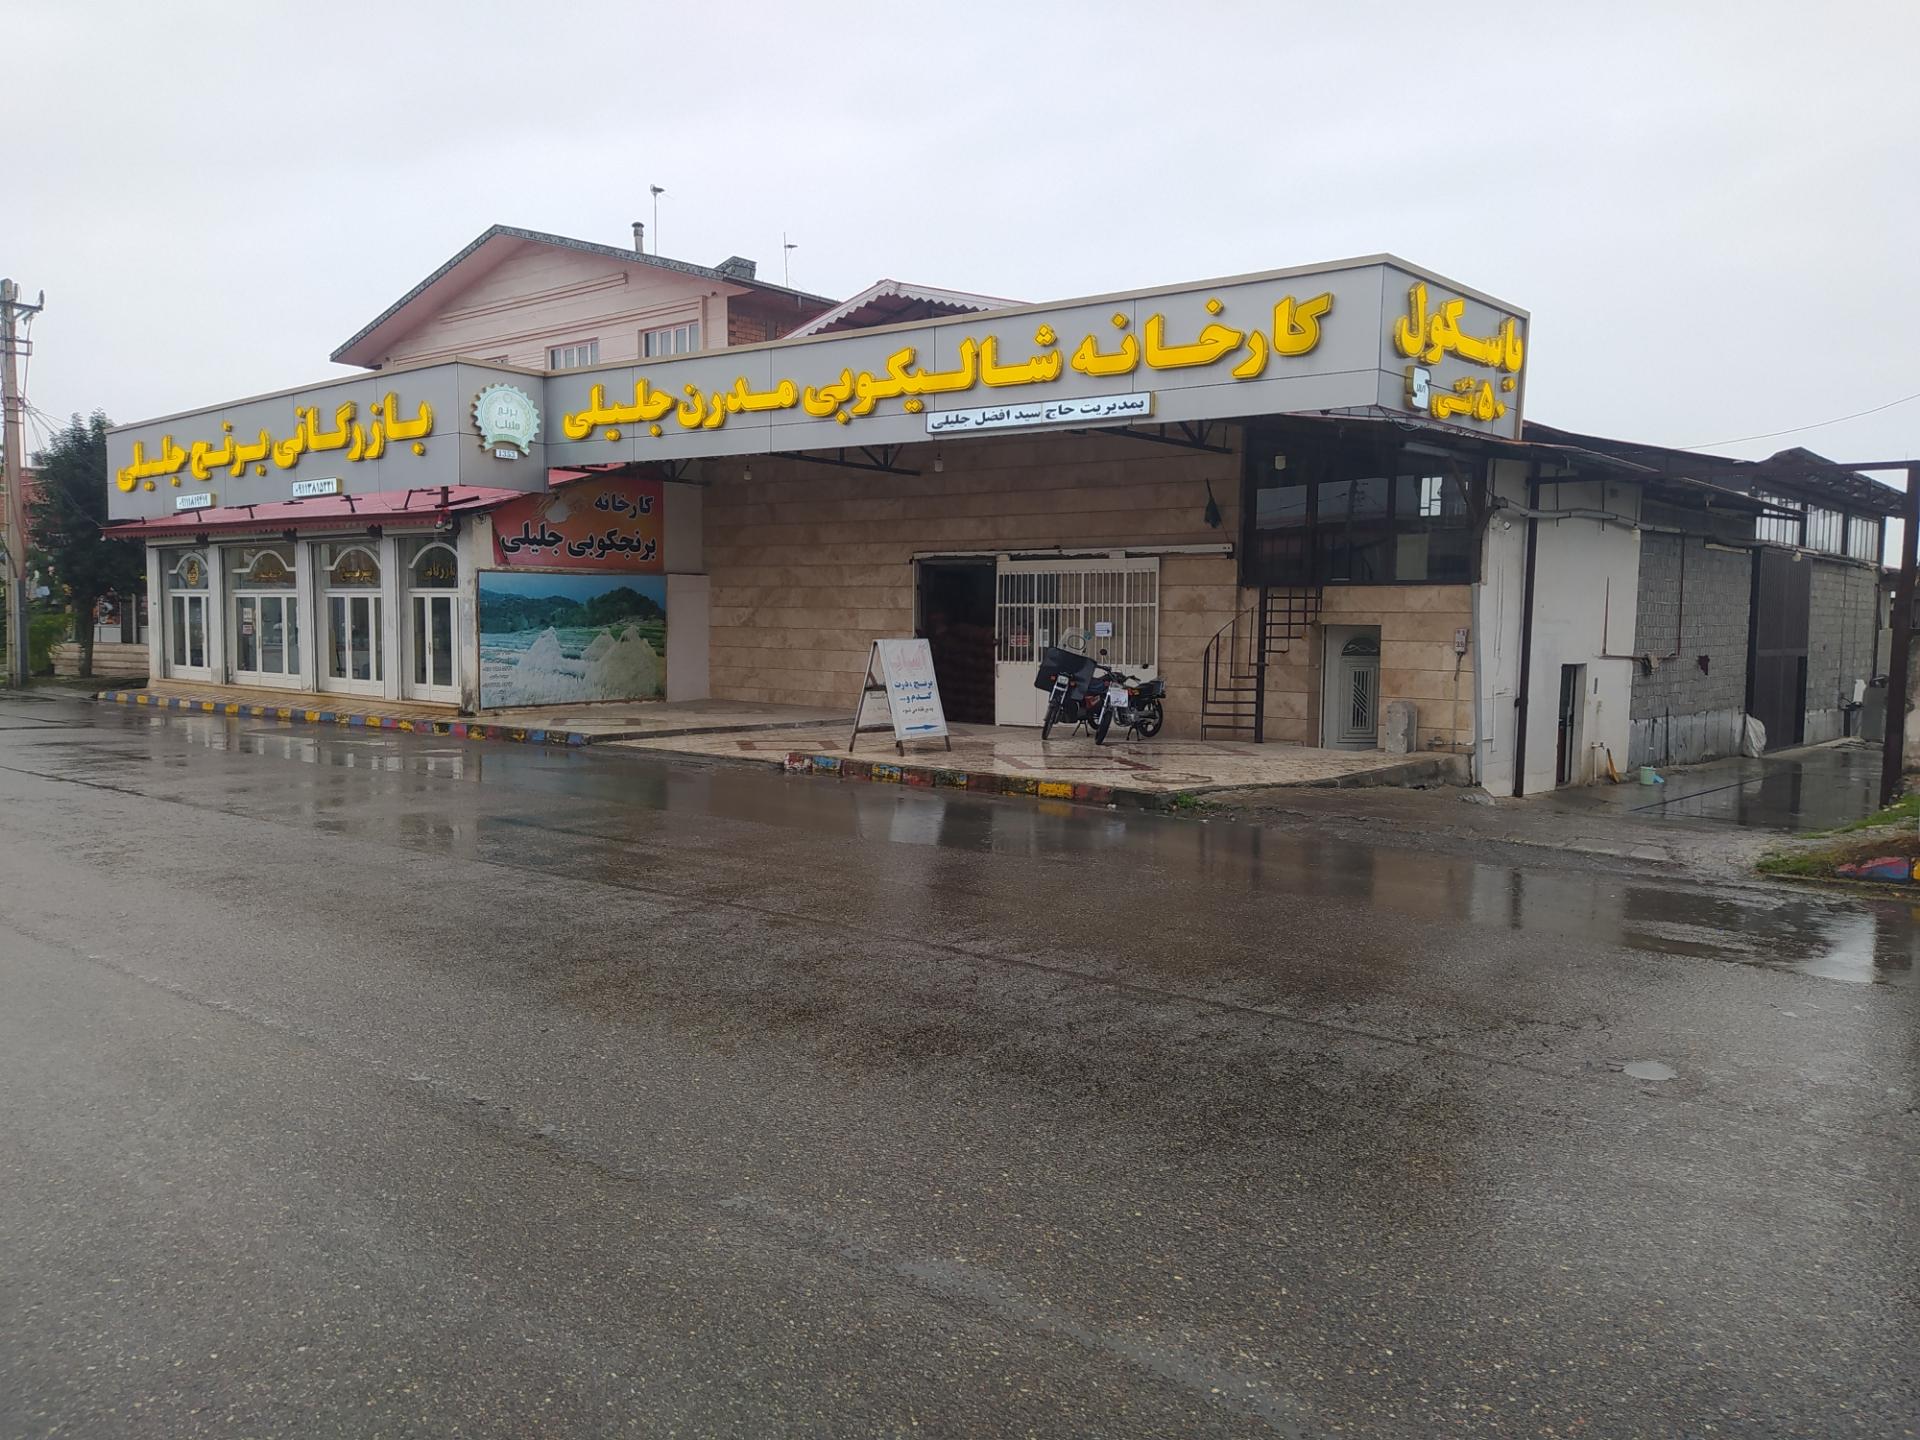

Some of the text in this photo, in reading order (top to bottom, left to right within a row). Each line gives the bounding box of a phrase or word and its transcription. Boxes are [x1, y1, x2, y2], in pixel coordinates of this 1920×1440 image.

[563, 292, 1334, 440] کارخانه شالیکوبی مدرن جلیلی
[1394, 282, 1523, 392] باسکول
[116, 391, 432, 493] بازرگانی برنج جلیلی
[931, 399, 1145, 430] بمدیریت حاج سید افضل جلیلی
[500, 520, 657, 560] برنجکوبی جلیلی
[595, 492, 655, 519] کارخانه
